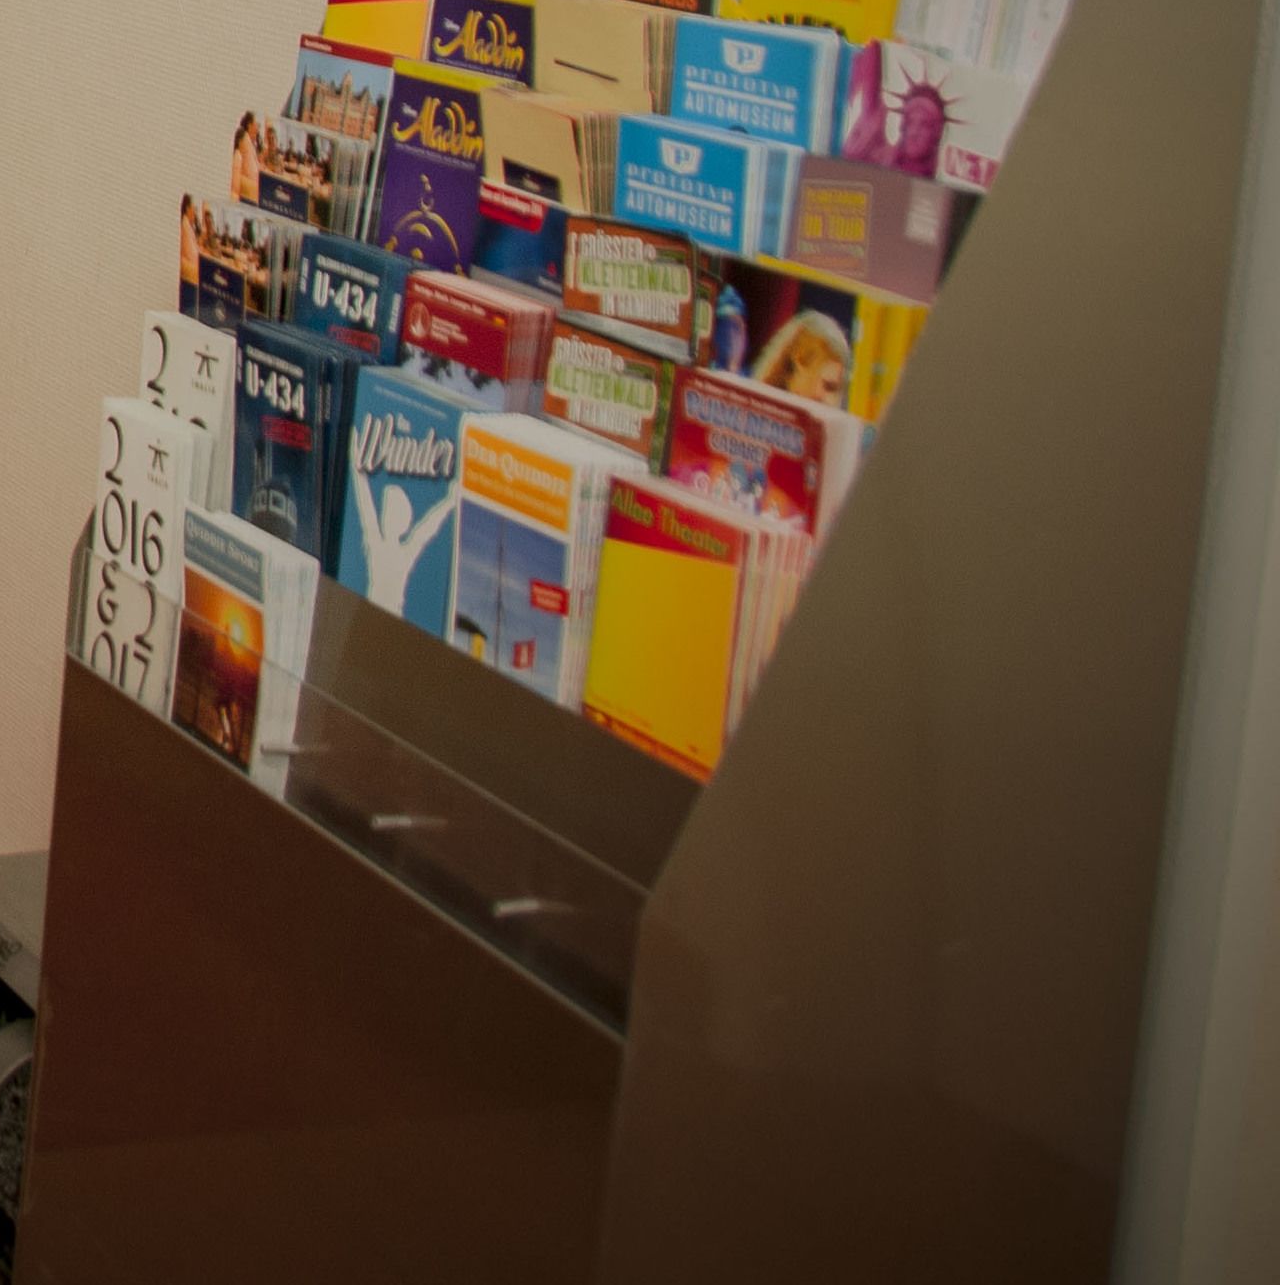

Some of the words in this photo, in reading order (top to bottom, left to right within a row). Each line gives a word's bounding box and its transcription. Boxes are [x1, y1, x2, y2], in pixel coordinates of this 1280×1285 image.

[432, 9, 526, 72] Aladdin
[392, 96, 485, 160] Aladdin
[685, 91, 795, 135] AUTOMUSEUM
[625, 190, 732, 237] AUTOMUSEUM
[350, 412, 456, 478] Wunder
[612, 487, 654, 528] Allee
[659, 505, 729, 558] Theater
